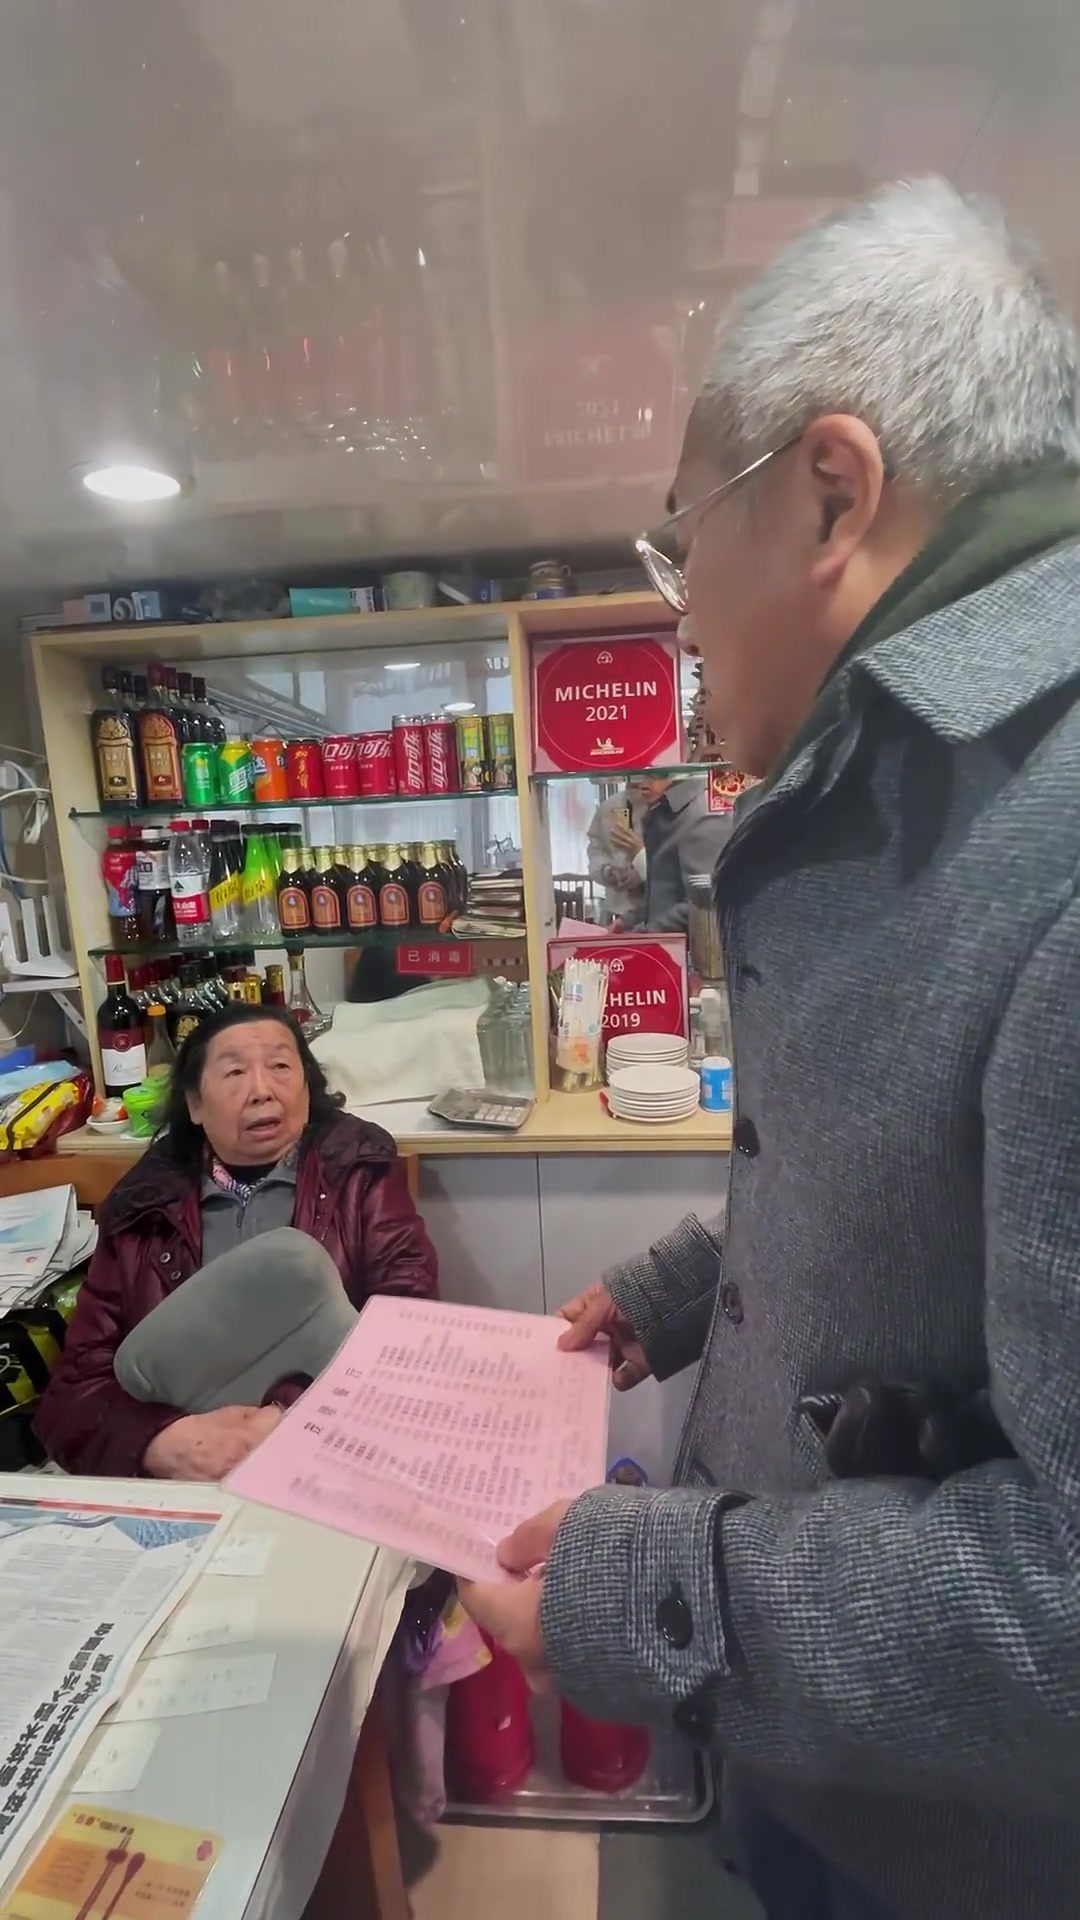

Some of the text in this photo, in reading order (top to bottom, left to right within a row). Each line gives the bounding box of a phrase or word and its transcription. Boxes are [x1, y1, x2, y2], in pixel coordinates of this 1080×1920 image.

[555, 681, 657, 702] MICHELIN
[585, 704, 627, 722] 2021
[403, 728, 424, 790] 可口可乐
[428, 727, 449, 789] 可口可乐
[407, 950, 461, 964] 已消毒
[603, 989, 667, 1008] HELIN
[602, 1012, 641, 1029] 2019
